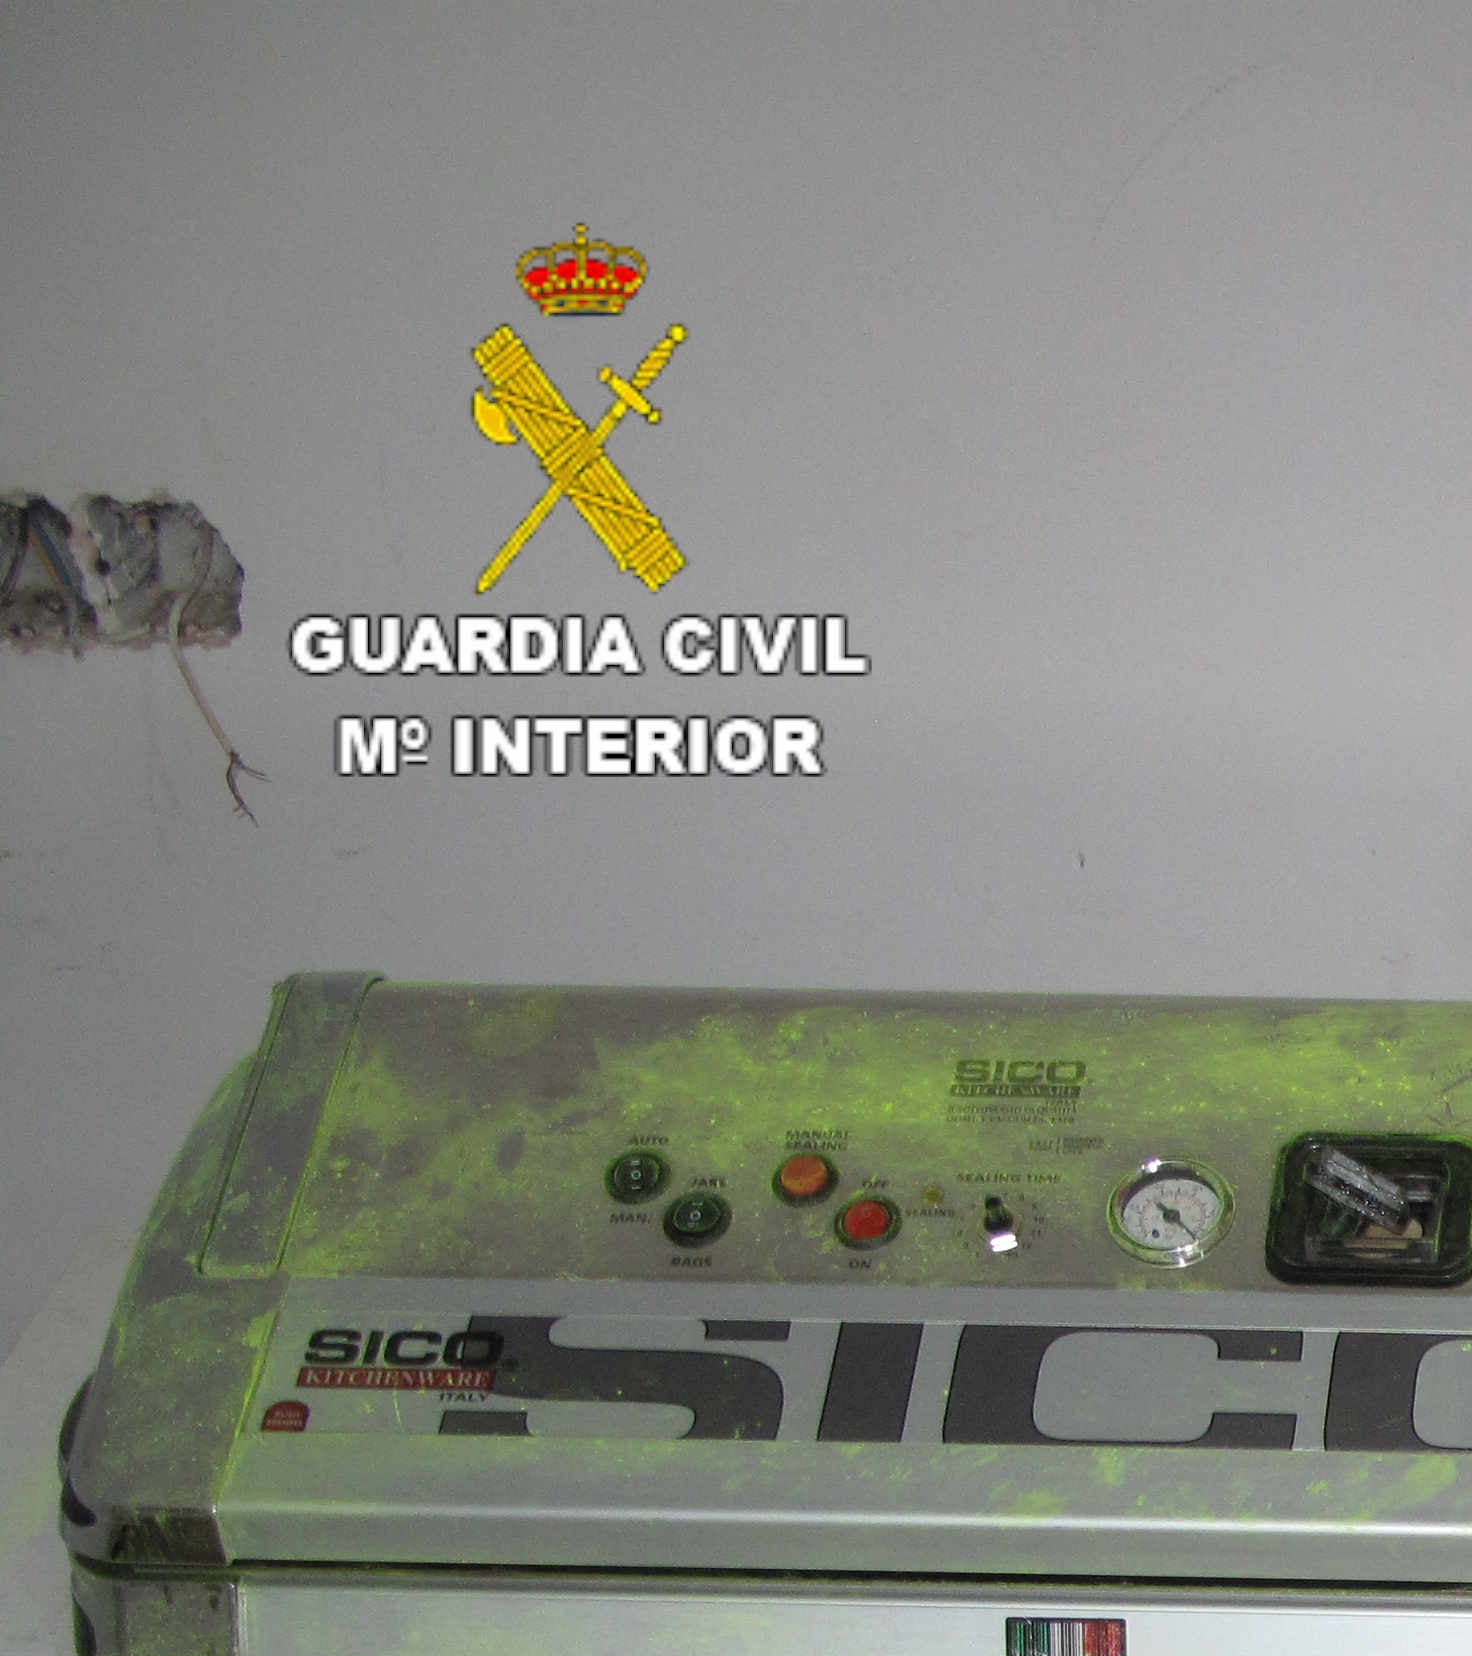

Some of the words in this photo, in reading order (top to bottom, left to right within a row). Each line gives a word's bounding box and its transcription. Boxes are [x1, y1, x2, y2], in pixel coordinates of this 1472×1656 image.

[954, 1059, 1087, 1085] SICO
[629, 1135, 669, 1146] AUTO
[848, 1258, 873, 1270] ON
[304, 1329, 505, 1366] SICO
[304, 1368, 491, 1388] KITCHENWARE
[439, 1392, 490, 1402] ITALY
